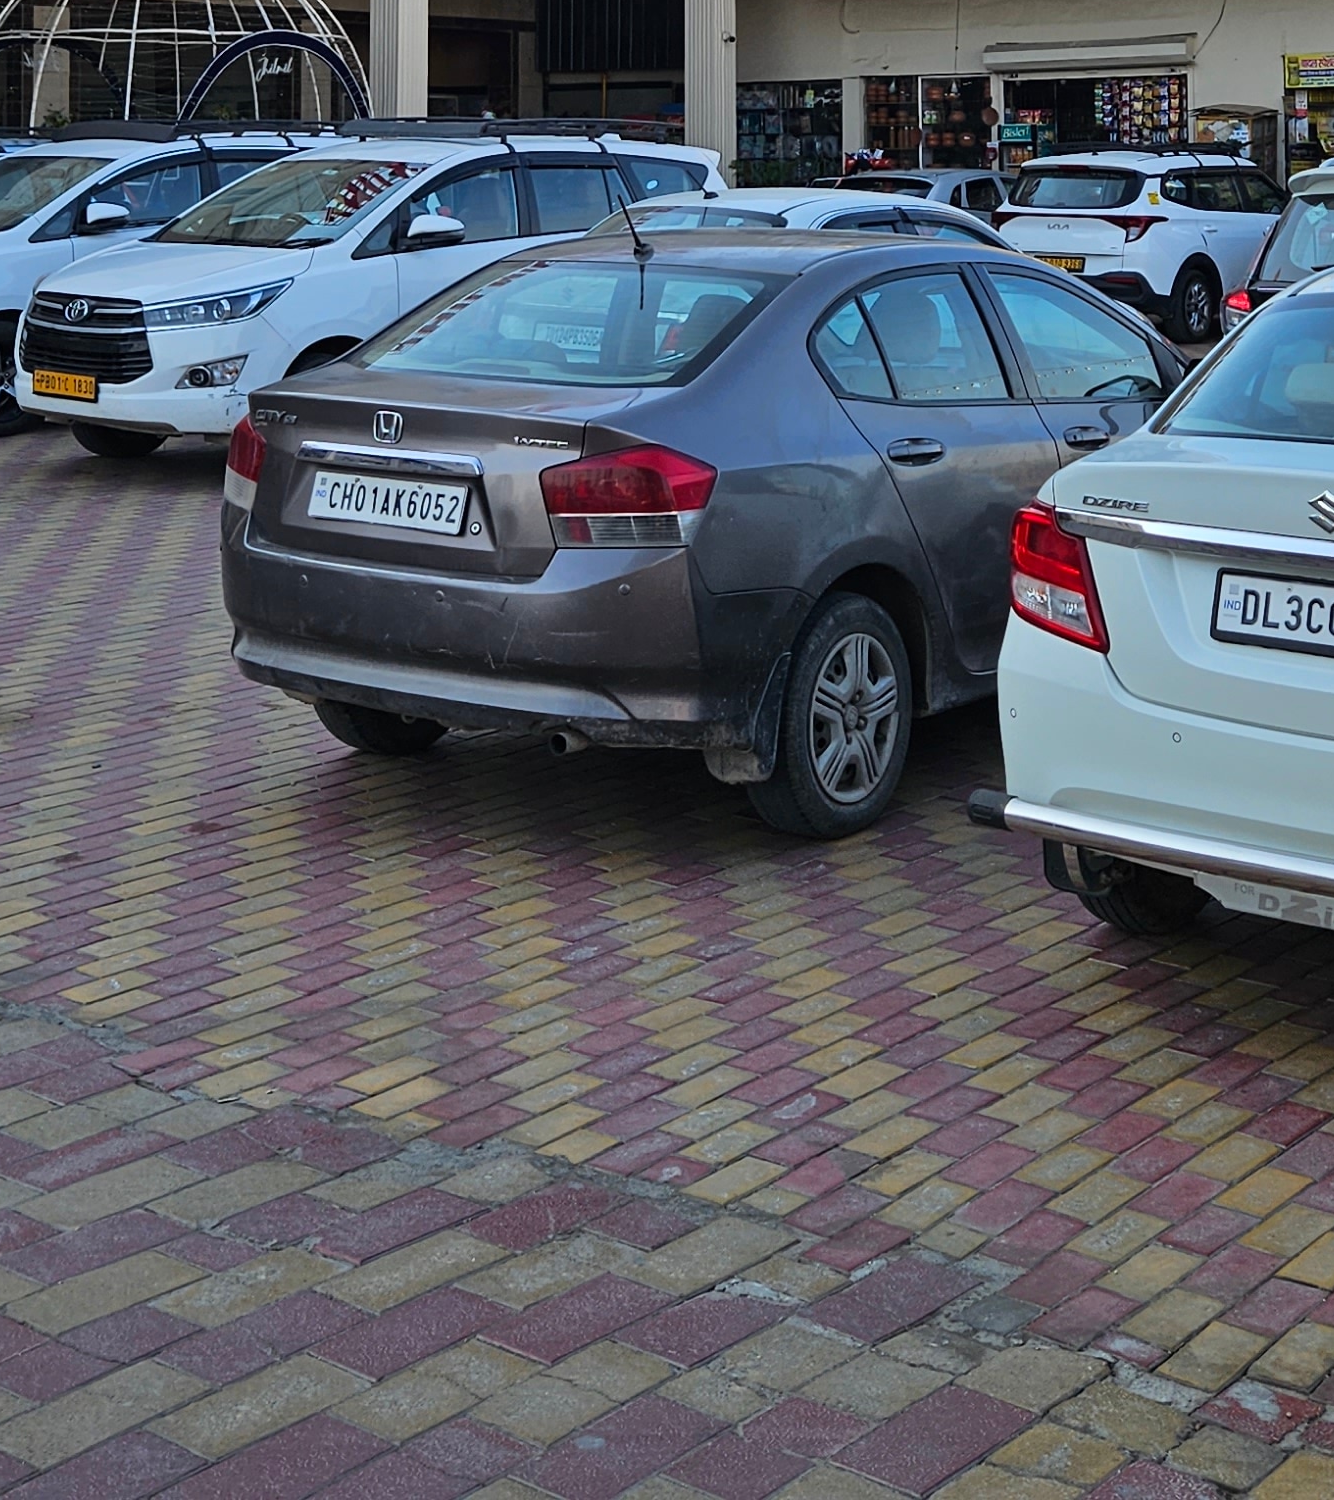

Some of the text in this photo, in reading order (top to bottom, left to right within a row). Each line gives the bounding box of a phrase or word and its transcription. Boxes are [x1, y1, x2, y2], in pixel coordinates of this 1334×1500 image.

[328, 481, 461, 524] CH01AK6052
[1081, 493, 1150, 513] DZIRE
[1223, 599, 1241, 612] IND
[1234, 882, 1255, 896] FOR
